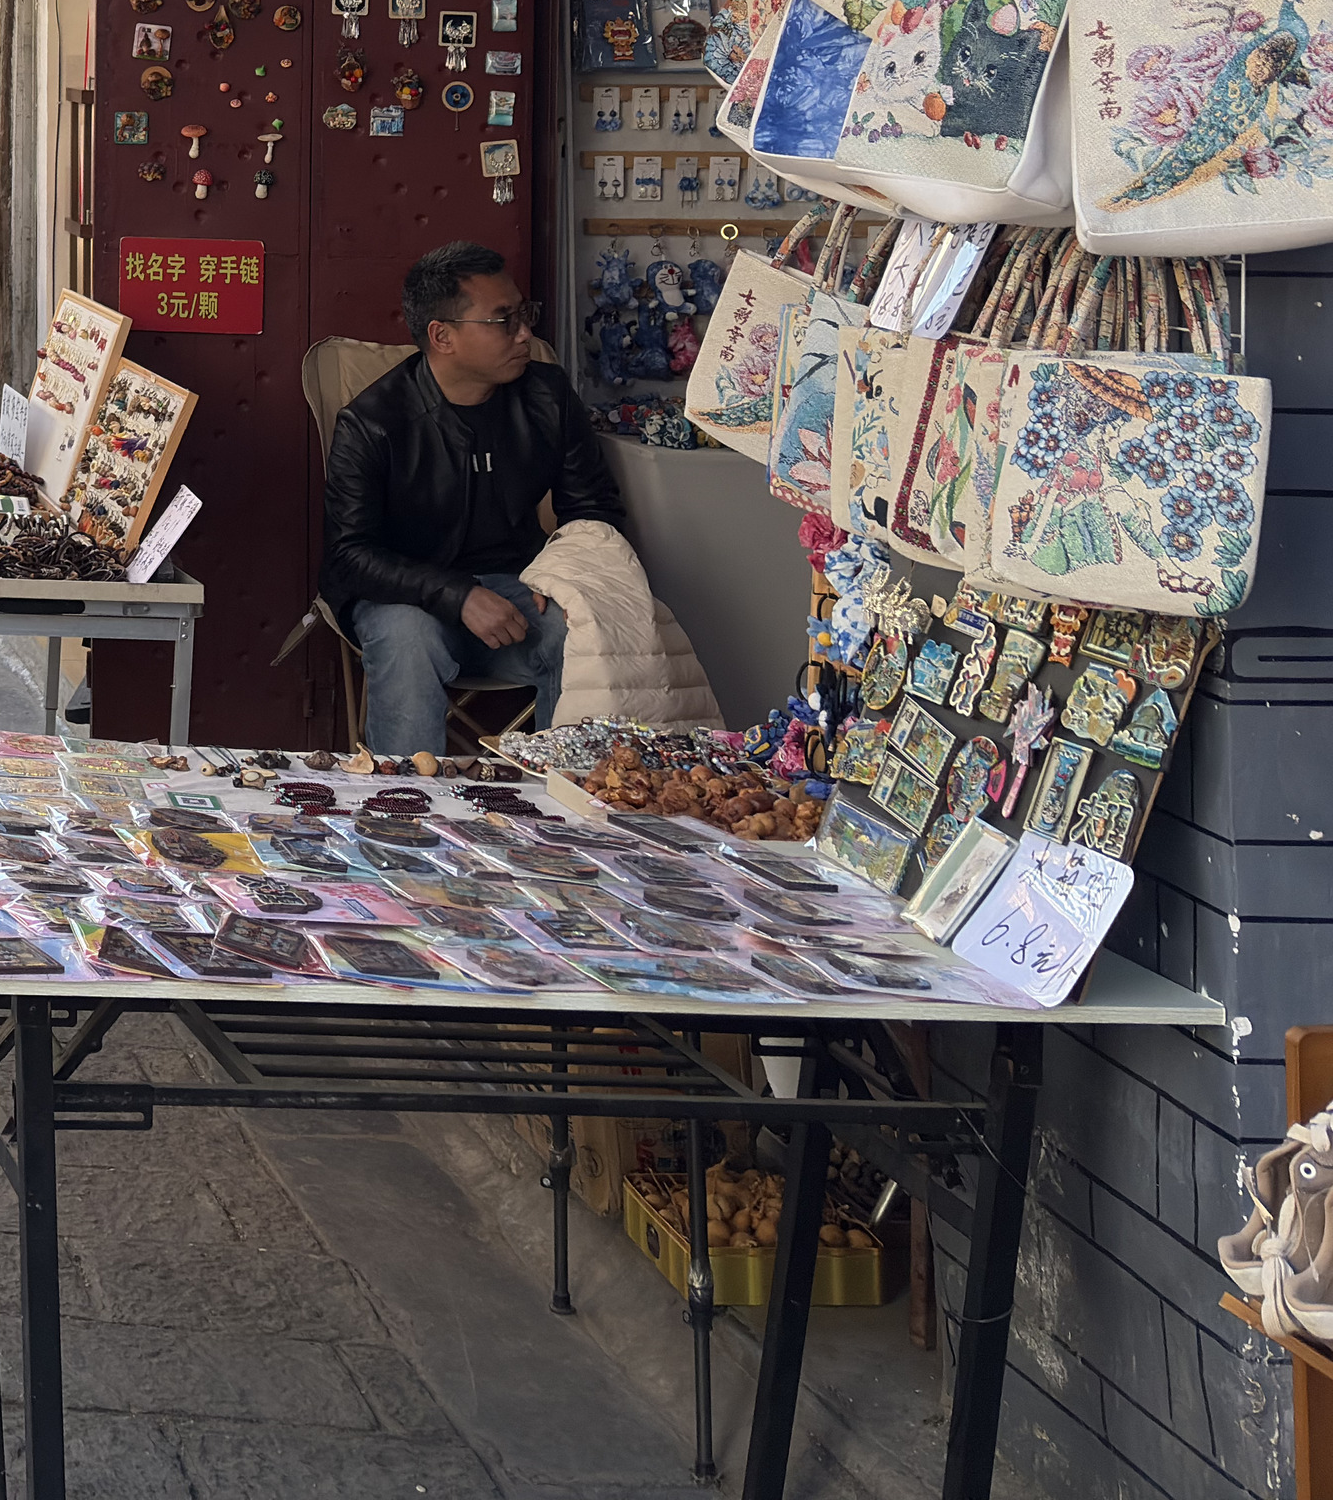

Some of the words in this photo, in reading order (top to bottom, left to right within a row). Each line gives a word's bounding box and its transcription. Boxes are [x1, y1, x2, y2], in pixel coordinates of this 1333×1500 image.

[125, 251, 186, 282] 找名字
[199, 254, 260, 285] 穿手链
[156, 291, 219, 320] 3元/颗
